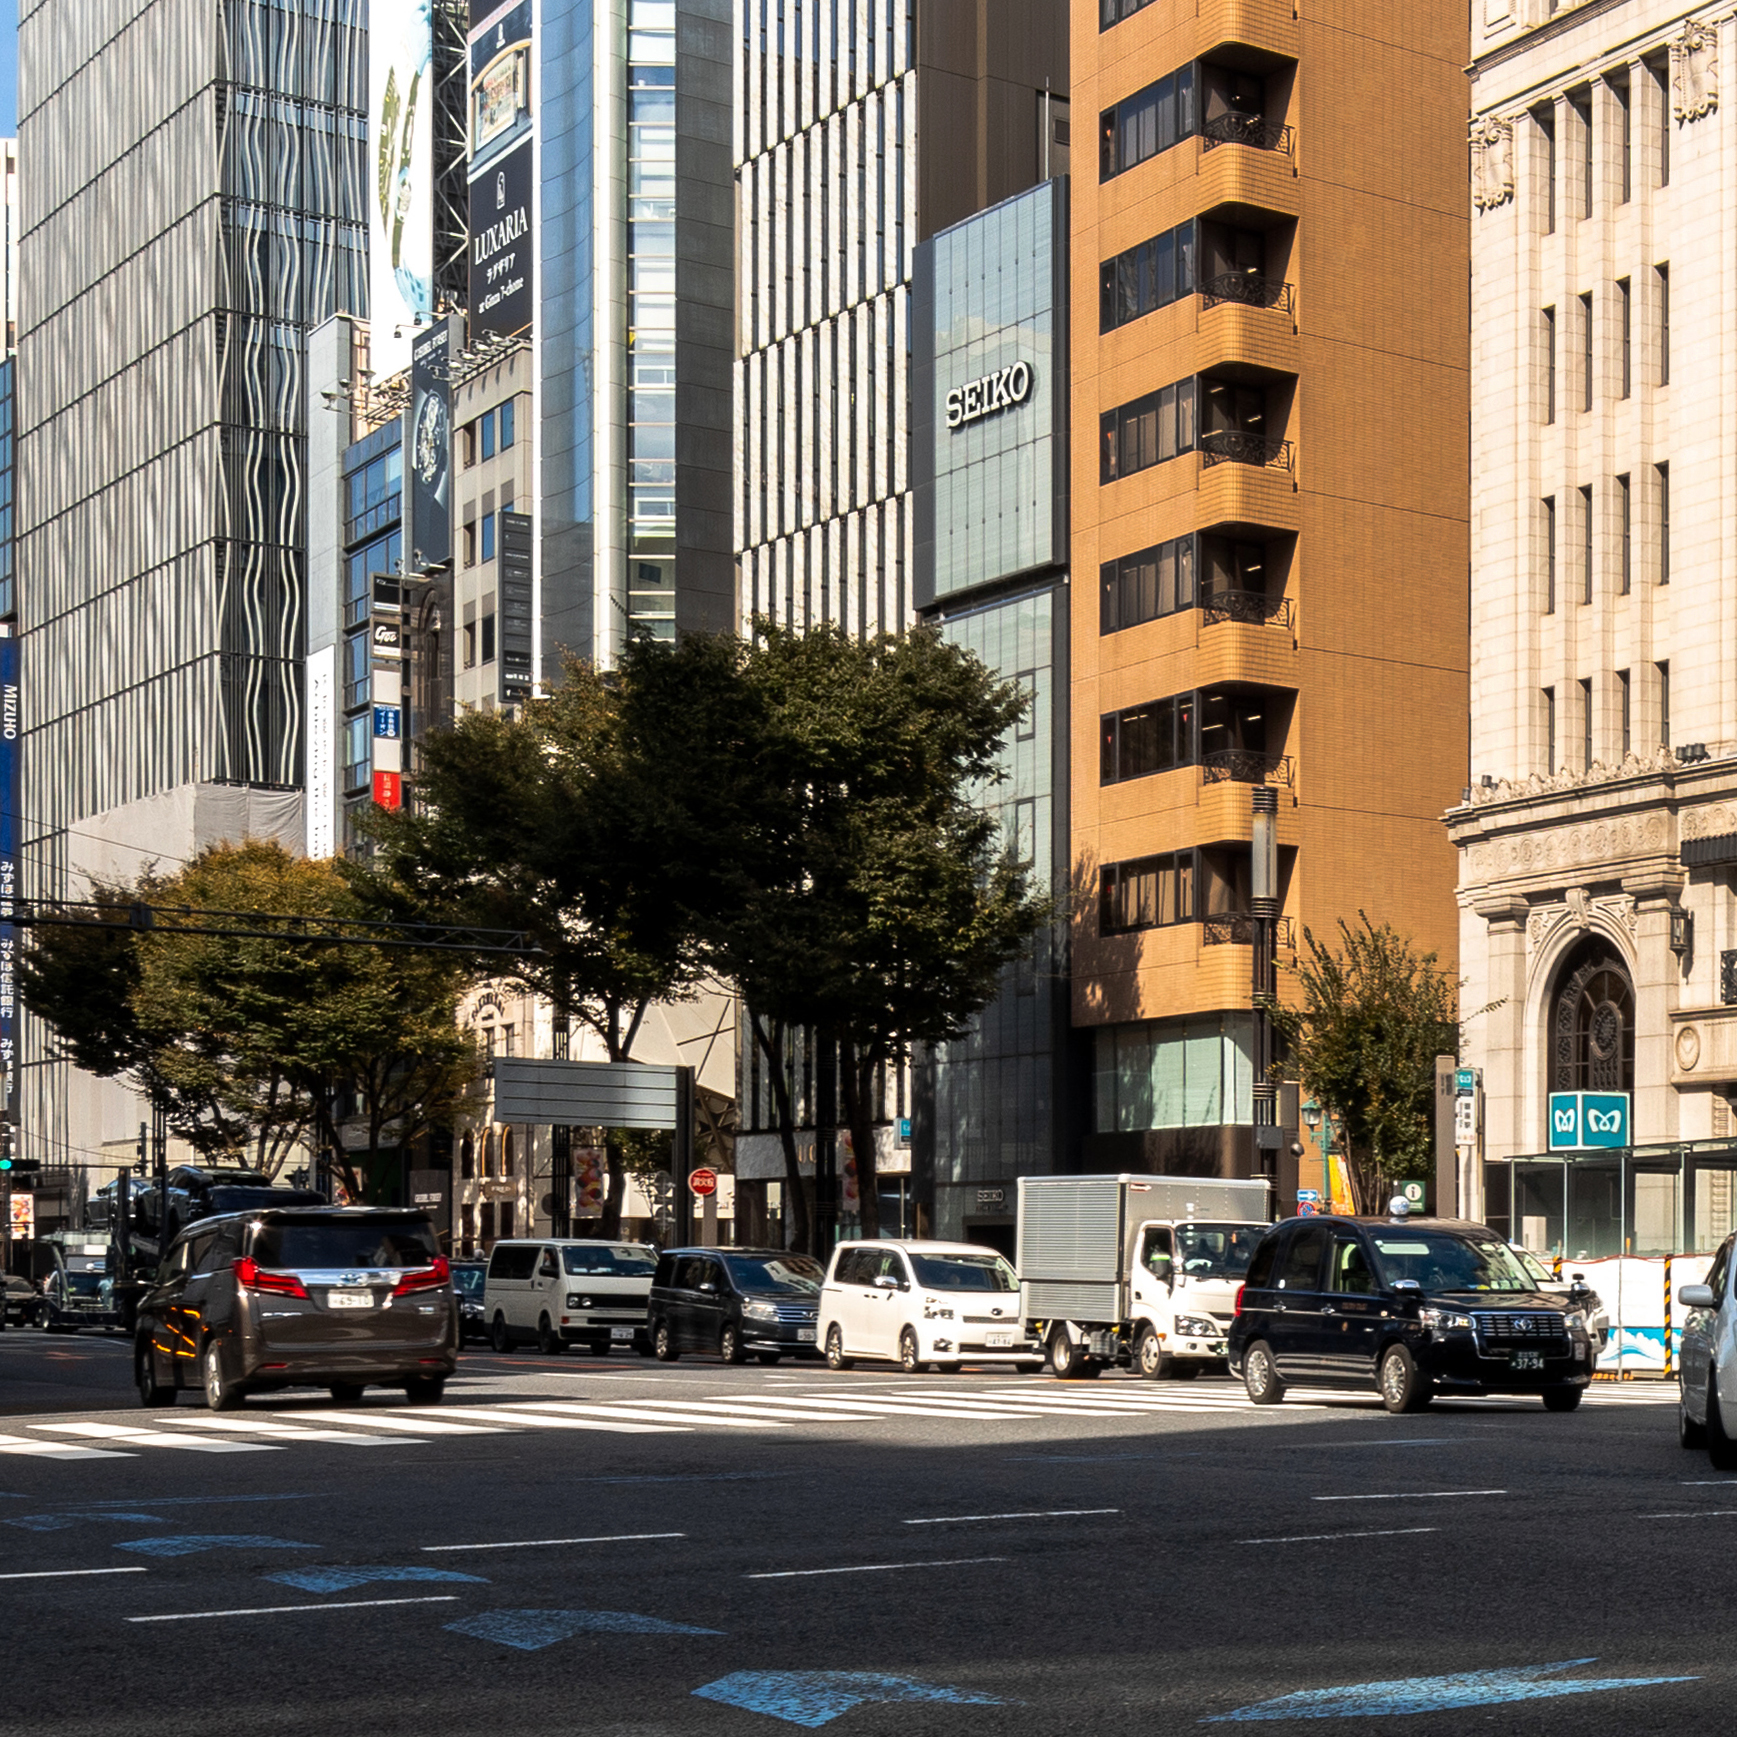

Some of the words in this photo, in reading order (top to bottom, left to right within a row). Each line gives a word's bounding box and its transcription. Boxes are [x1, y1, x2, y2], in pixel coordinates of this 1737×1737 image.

[474, 206, 529, 265] LUXARIA
[945, 360, 1029, 428] SEIKO
[3, 684, 18, 740] MIZUHO
[977, 1189, 1004, 1202] SEIKO
[1516, 1358, 1544, 1369] 37-94
